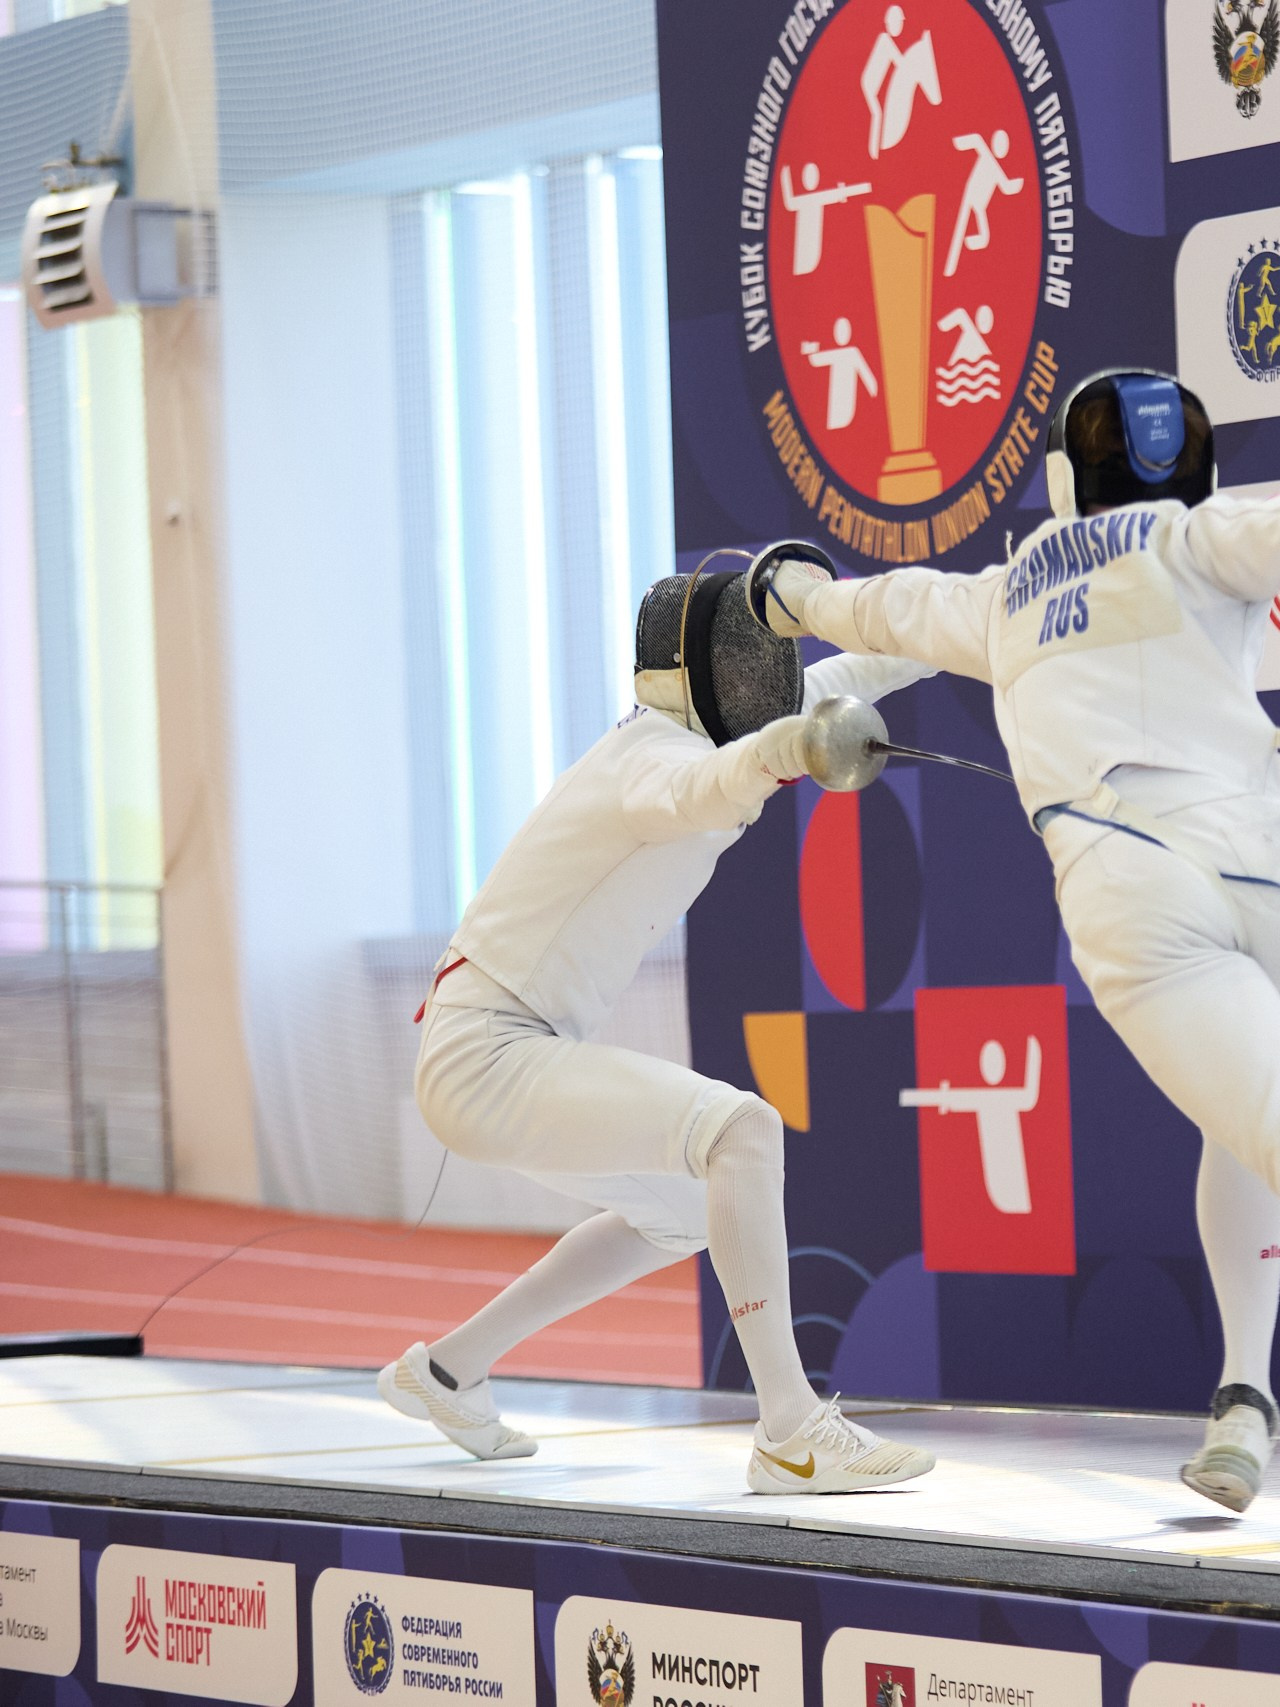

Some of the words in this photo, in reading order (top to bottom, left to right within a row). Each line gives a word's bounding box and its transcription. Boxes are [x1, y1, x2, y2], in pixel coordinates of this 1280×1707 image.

[740, 56, 792, 230] СОЮЗНОГО
[1034, 92, 1074, 308] ПЯТИБОРЬЮ
[740, 242, 771, 352] КУБОК
[931, 481, 991, 554] UNION
[984, 406, 1039, 503] STATE
[1024, 340, 1059, 414] CUP
[1038, 582, 1090, 646] RUS
[0, 1565, 36, 1584] тамент
[165, 1579, 266, 1629] МОСКОВСКИЙ
[6, 1618, 48, 1641] Москвы
[165, 1622, 212, 1666] СПОРТ
[401, 1615, 462, 1639] ФЕДЕРАЦИЯ
[402, 1643, 478, 1669] СОВРЕМЕННОГО
[651, 1652, 760, 1693] МИНСПОРТ
[403, 1669, 461, 1694] ПЯТИБОРЬЯ
[465, 1679, 503, 1699] РОССИИ
[927, 1673, 1034, 1707] Департамент
